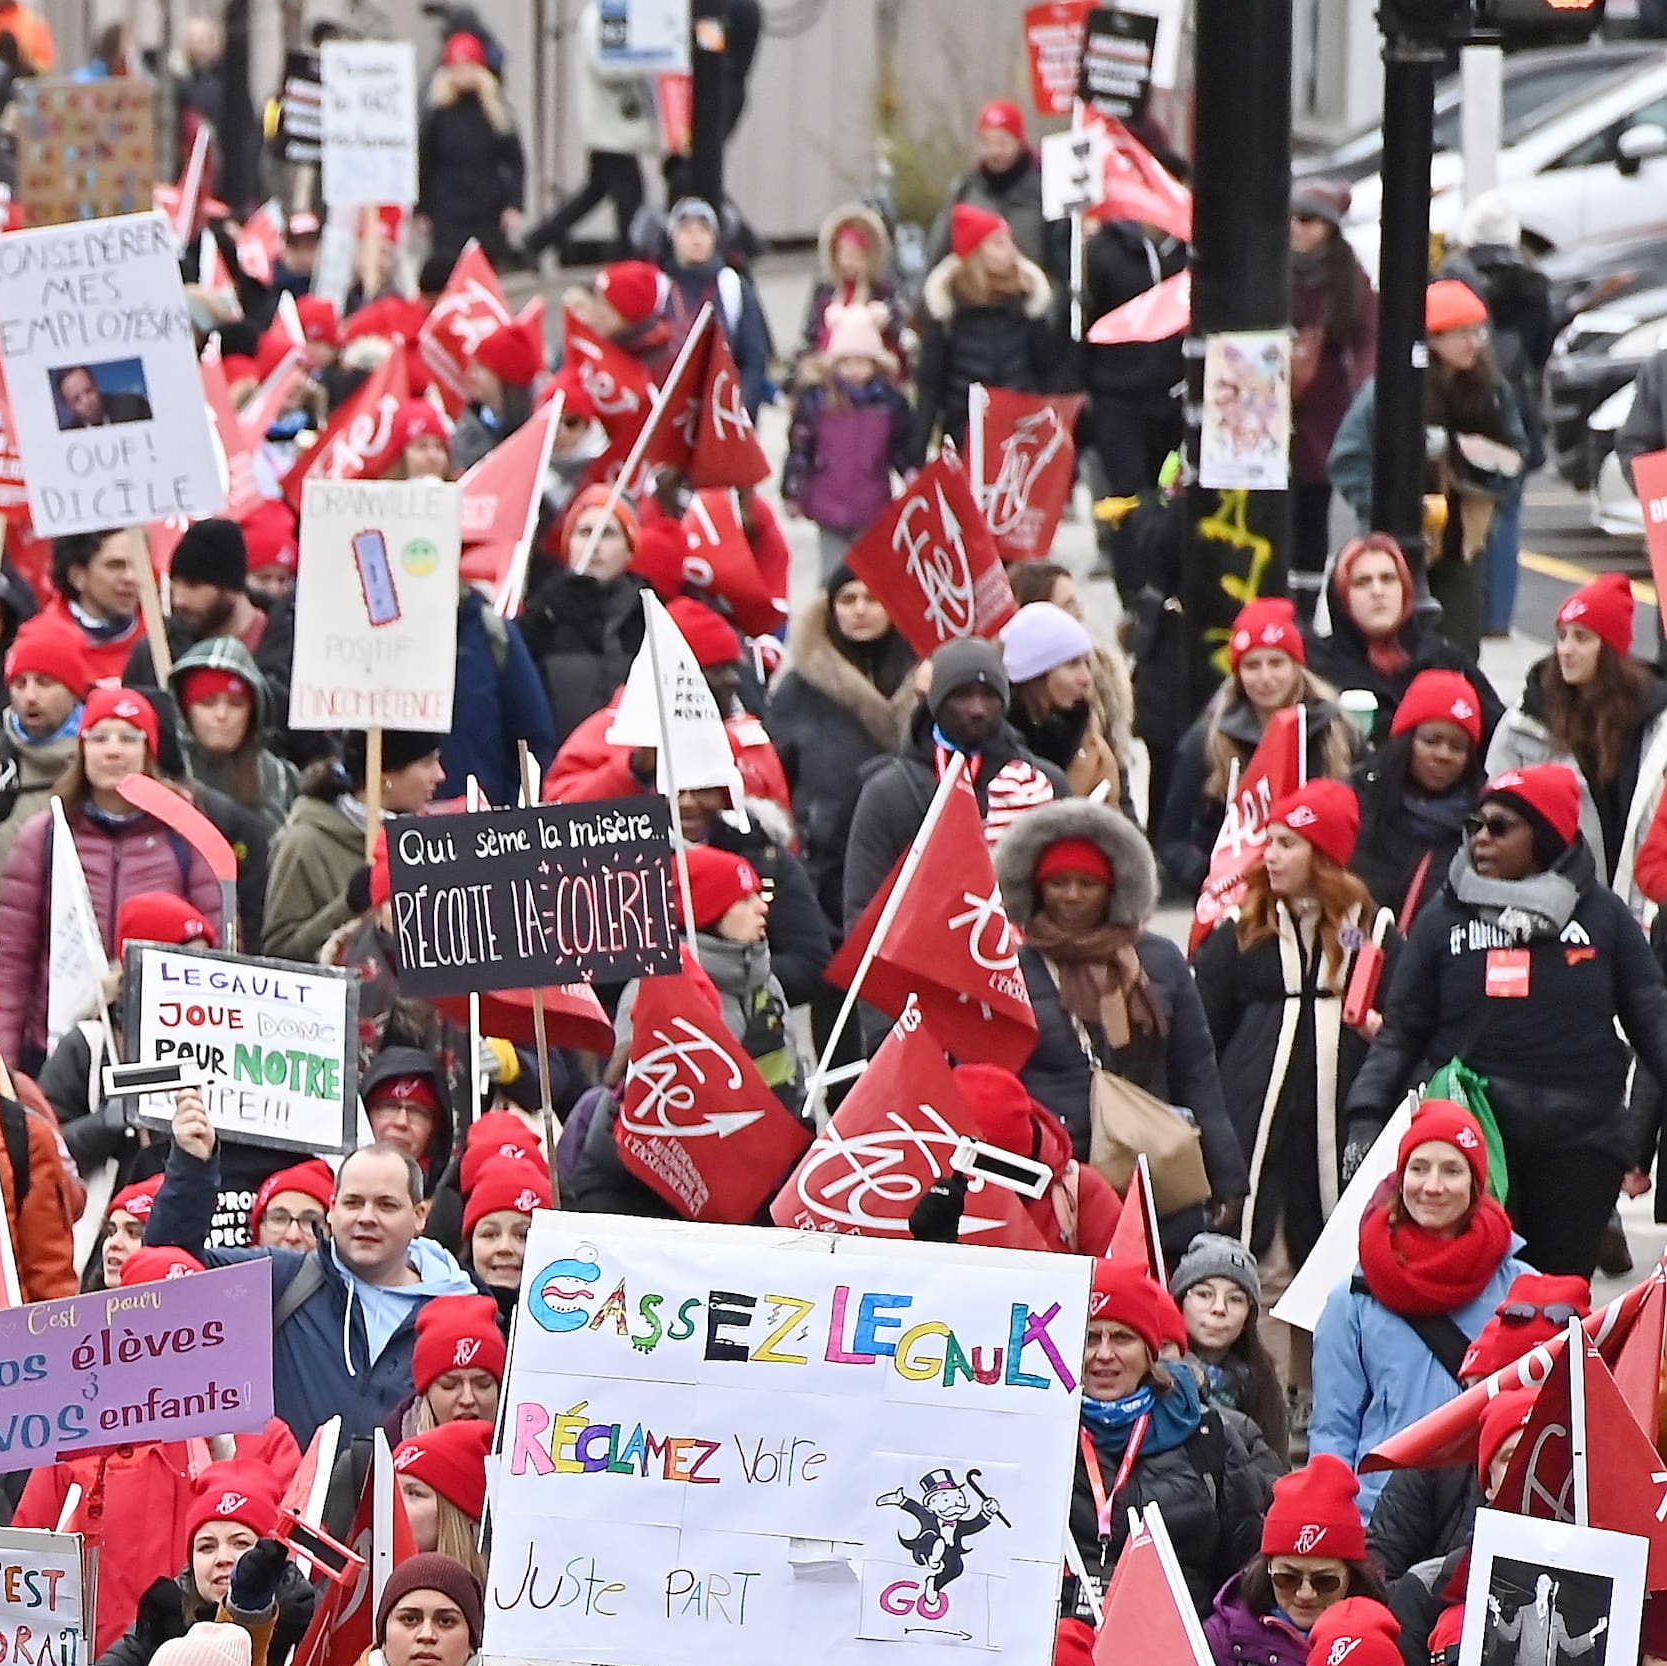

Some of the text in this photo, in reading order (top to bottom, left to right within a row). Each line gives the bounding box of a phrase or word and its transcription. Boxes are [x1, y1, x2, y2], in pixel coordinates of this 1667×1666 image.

[41, 271, 122, 305] MES
[40, 475, 194, 522] DICILE
[308, 484, 444, 519] DRAINVILLE
[399, 829, 458, 866] Qui
[475, 827, 532, 858] sème
[538, 818, 562, 850] la
[394, 884, 503, 969] RÉCOLTE
[511, 878, 548, 959] LA
[161, 961, 312, 1003] LEGAULT
[159, 1002, 243, 1029] JOUE
[154, 1038, 340, 1100] POUR NOTRE
[105, 1289, 162, 1326] pour
[527, 1256, 815, 1364] CASSEZ
[72, 1320, 225, 1370] élèves
[511, 1400, 722, 1484] RÉCLAMEZ
[666, 1568, 761, 1624] PART
[880, 1580, 949, 1620] GO
